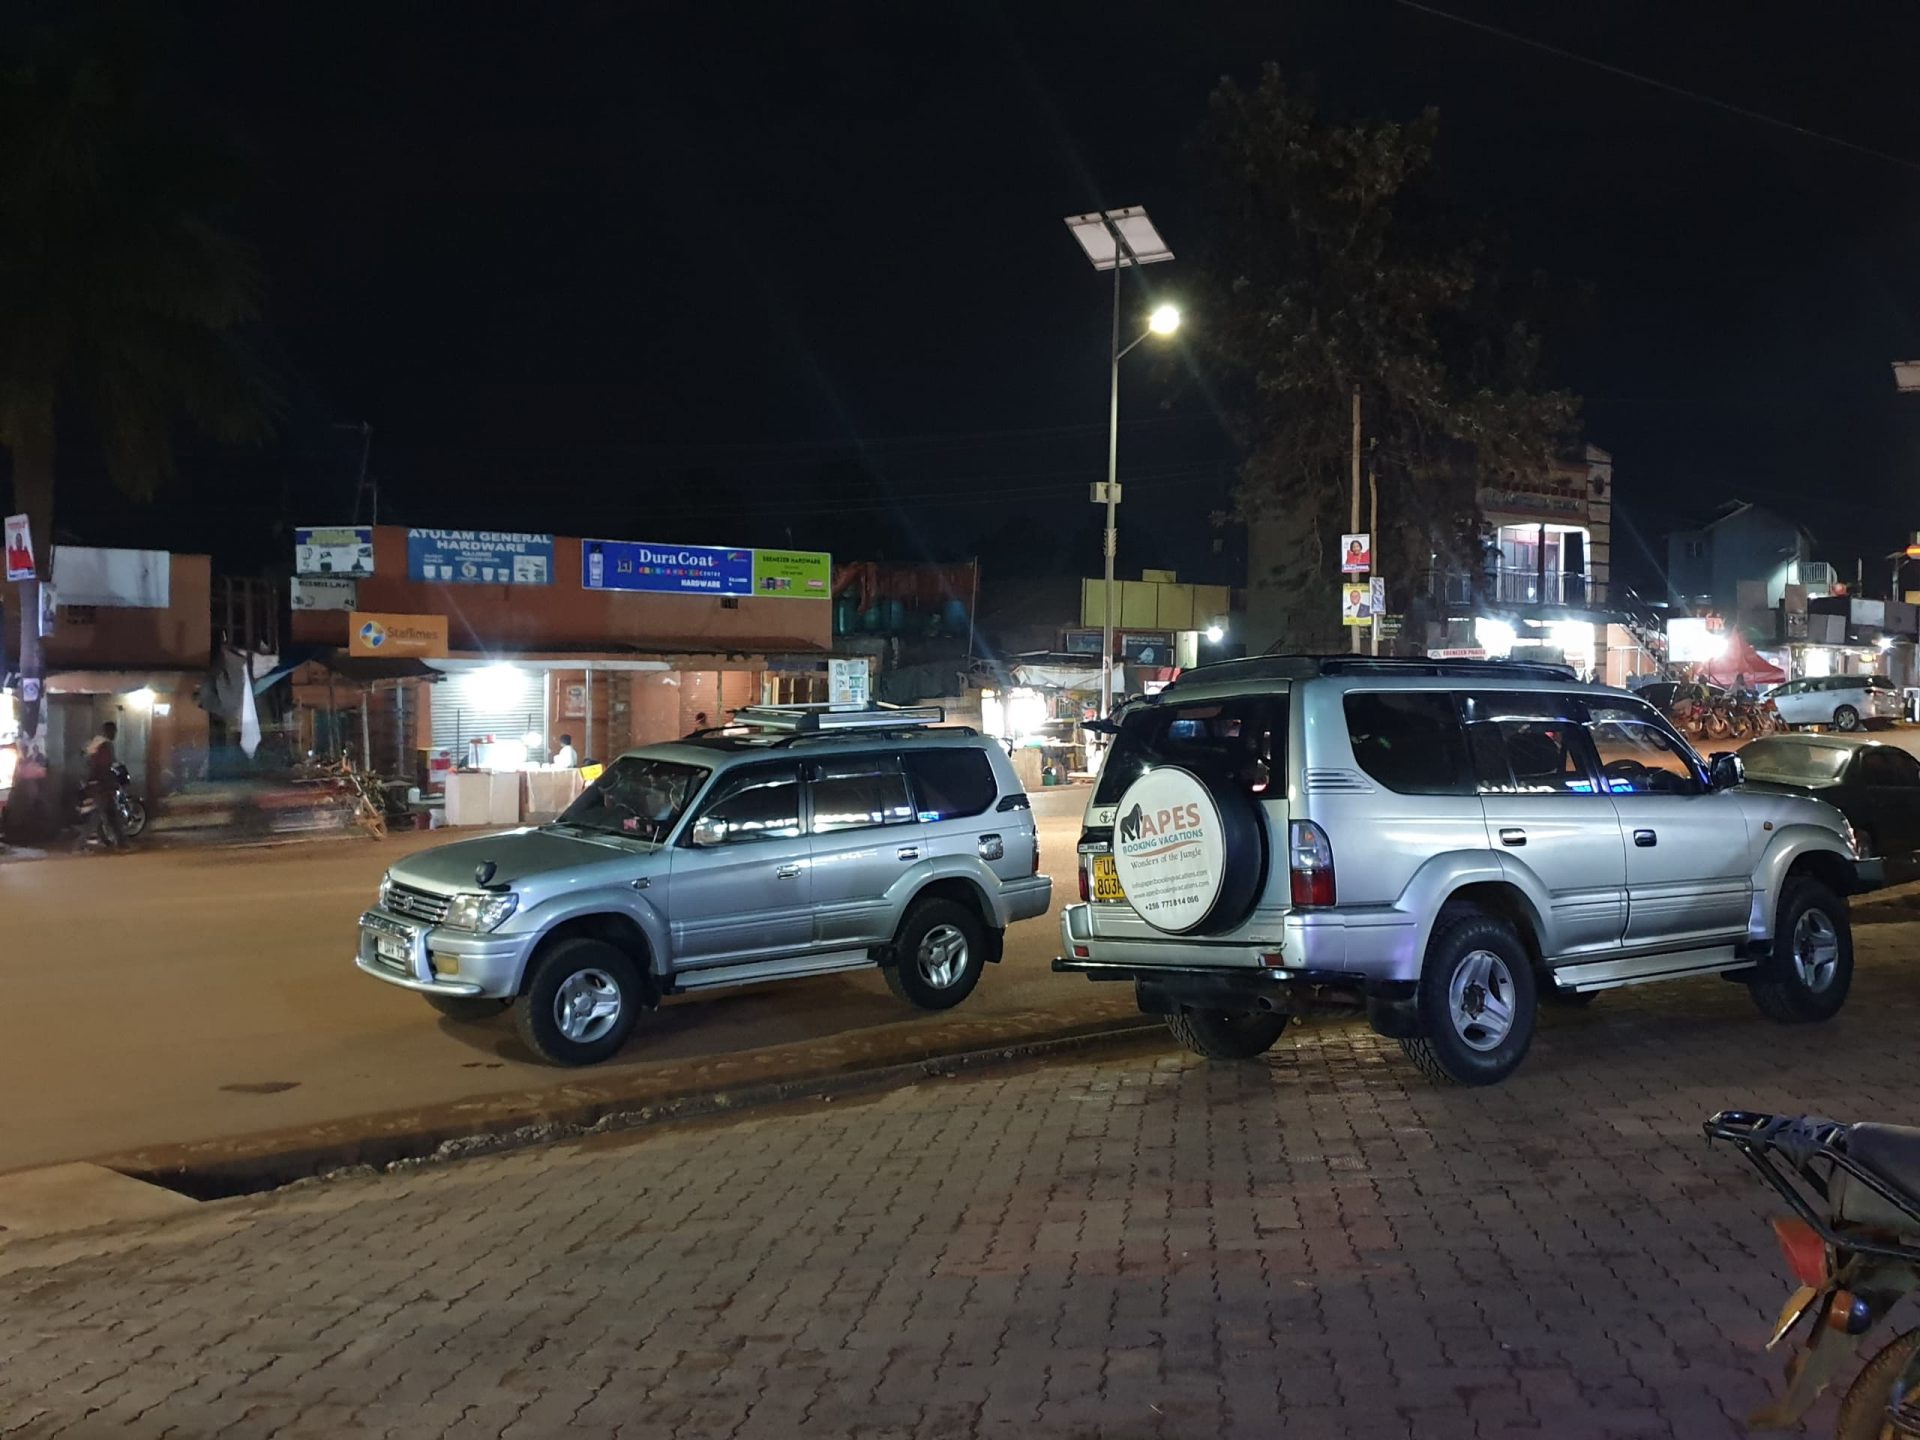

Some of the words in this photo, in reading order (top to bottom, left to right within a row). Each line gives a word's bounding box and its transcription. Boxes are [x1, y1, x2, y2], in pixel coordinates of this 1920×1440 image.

[479, 531, 551, 544] GENERAL
[436, 540, 526, 553] HARDWARE
[639, 549, 714, 567] DuraCoat
[790, 557, 821, 565] HARDWARE
[681, 579, 721, 588] HARDWARE
[1141, 802, 1201, 838] APES
[1122, 839, 1157, 854] BOOKING
[1158, 828, 1204, 845] VACATIONS
[1130, 857, 1159, 870] Wonders
[1160, 854, 1168, 863] of
[1168, 851, 1179, 861] the
[1180, 847, 1202, 862] Jungle
